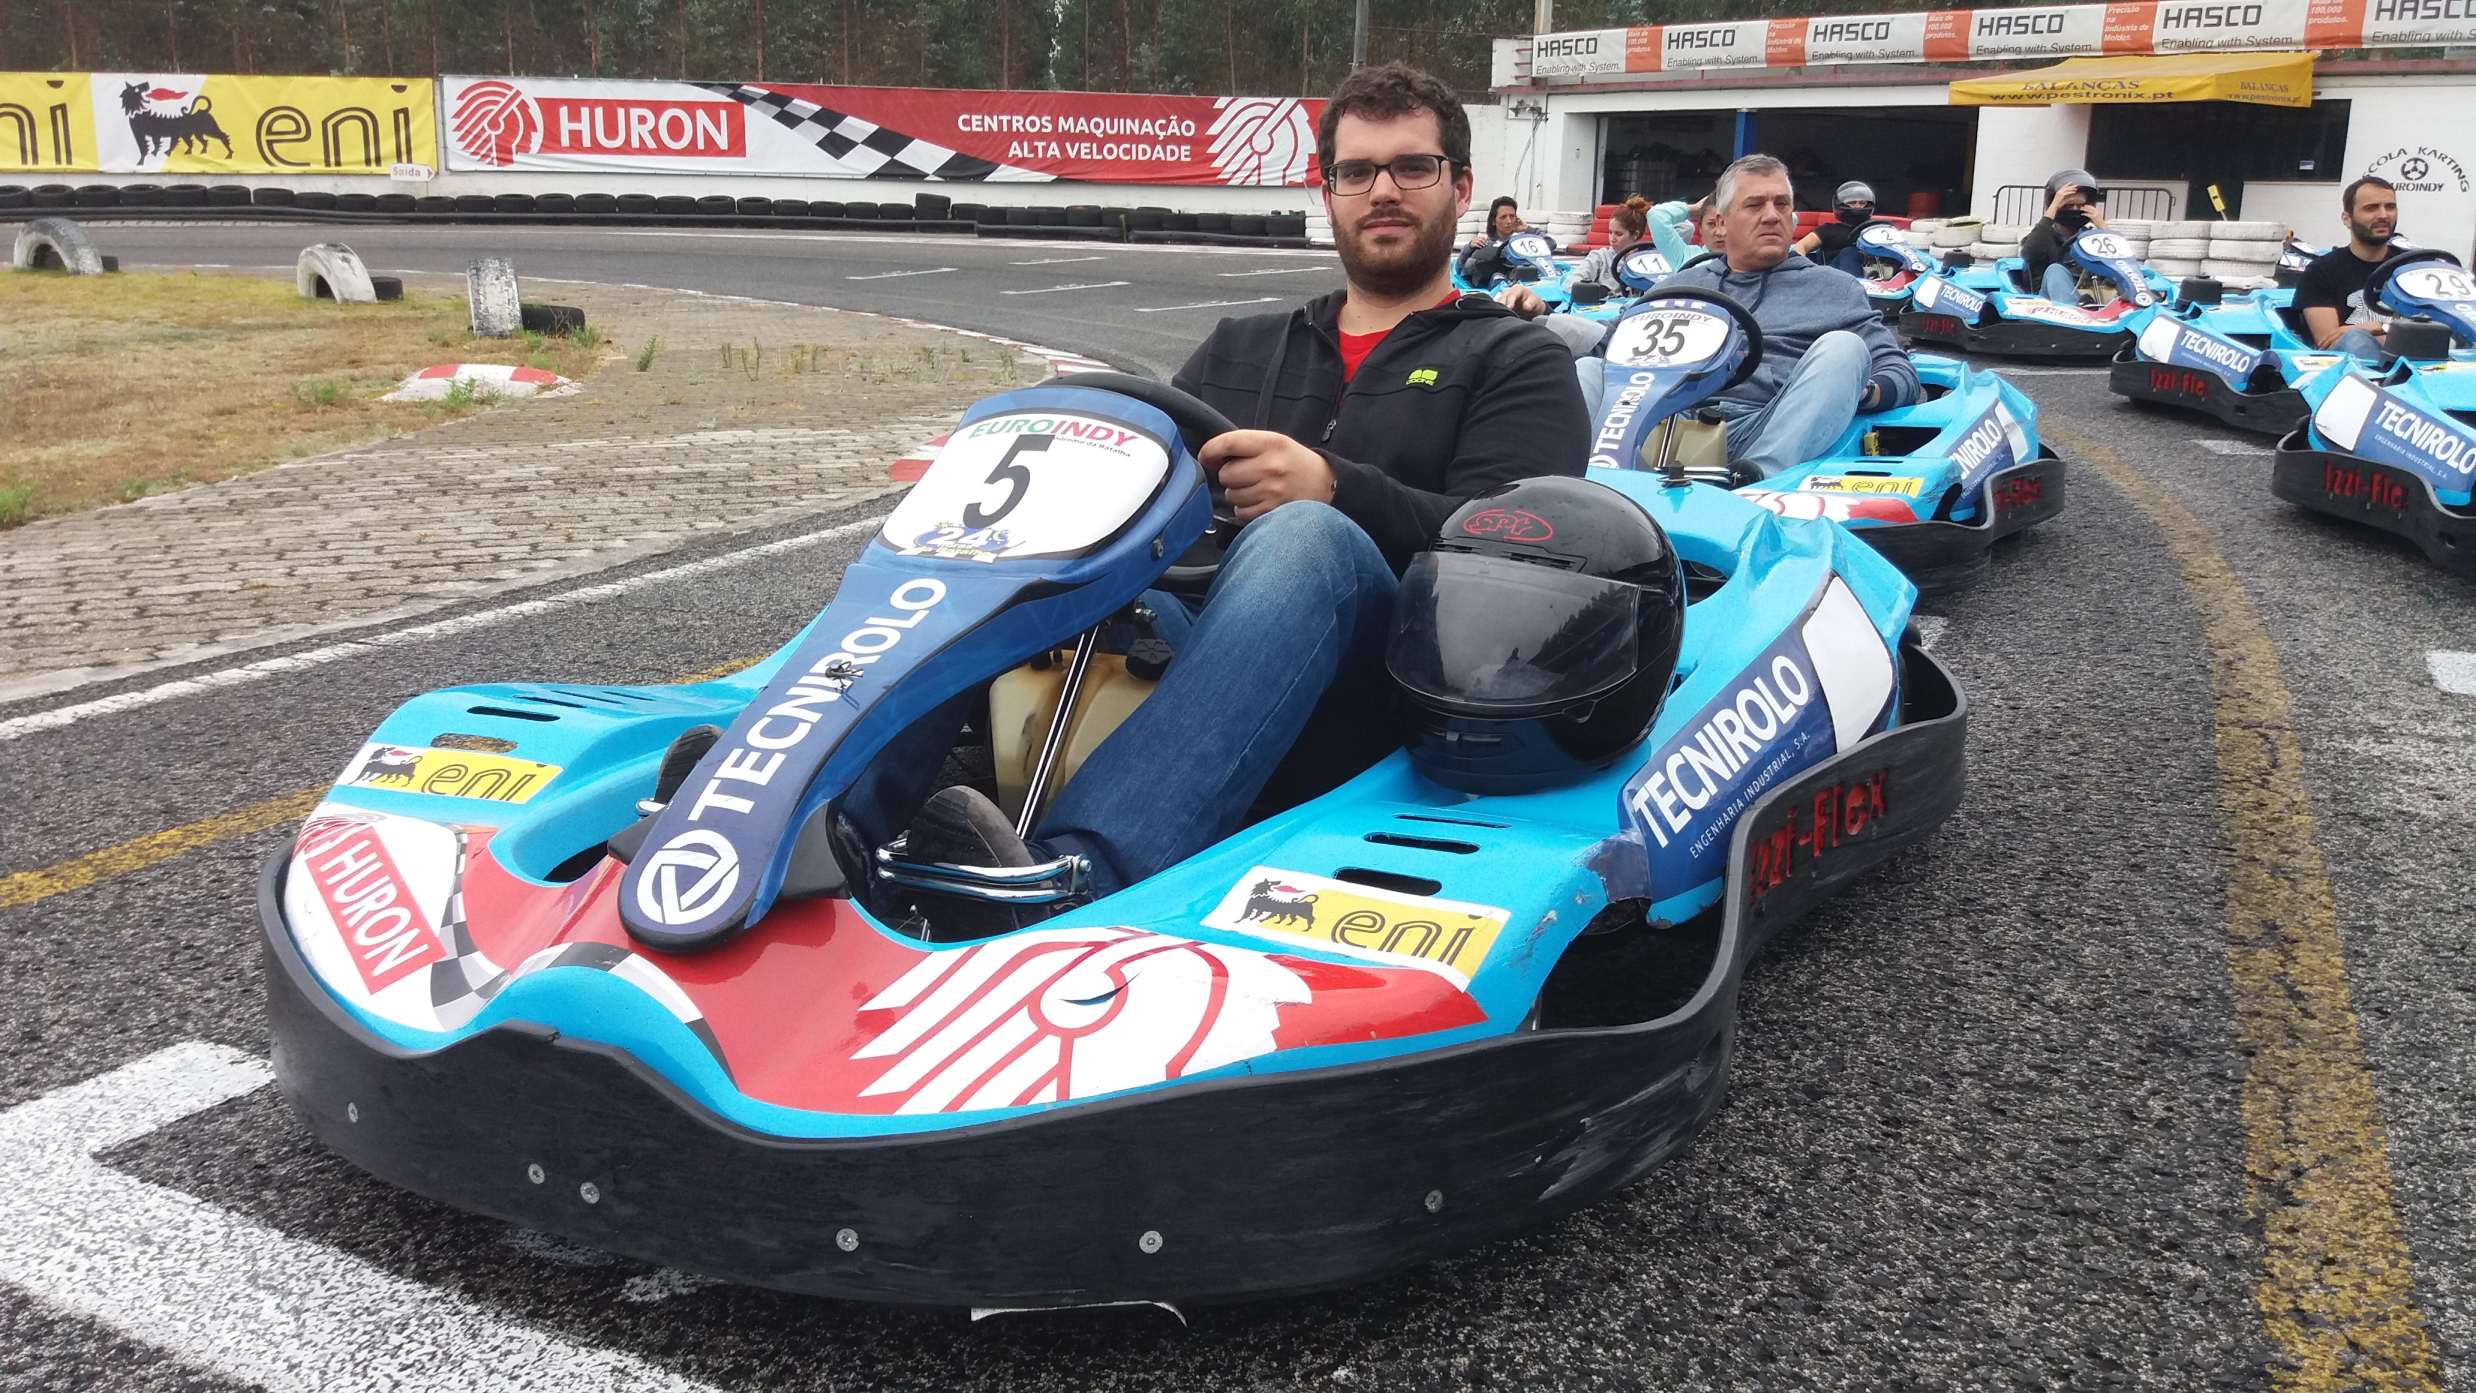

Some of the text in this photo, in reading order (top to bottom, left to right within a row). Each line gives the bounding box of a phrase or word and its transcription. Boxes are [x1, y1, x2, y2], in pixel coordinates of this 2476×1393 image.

[1977, 14, 2065, 36] HASCO
[2163, 5, 2262, 29] HASCO
[1668, 29, 1735, 49] HASCO
[1813, 22, 1891, 42] HASCO
[2162, 38, 2214, 49] Enabling
[2218, 37, 2242, 46] with
[2372, 31, 2430, 42] Enabling
[2436, 30, 2463, 40] with
[1537, 38, 1598, 58] HASCO
[1855, 50, 1875, 59] with
[1977, 45, 2022, 55] Enabling
[2025, 44, 2047, 53] with
[1667, 58, 1702, 68] Enabling
[1705, 56, 1721, 65] with
[0, 80, 74, 165] ni
[256, 84, 412, 167] eni
[559, 105, 729, 150] HURON
[957, 113, 1196, 139] CENTROS MAQUINAÇÃO
[1008, 142, 1192, 162] ALTA VELOCIDADE
[2362, 146, 2470, 193] COLA KARTING
[2392, 182, 2445, 192] UROINDY
[1519, 239, 1539, 254] 16
[1881, 229, 1894, 241] 2
[2091, 237, 2118, 255] 26
[2425, 273, 2471, 296] 29
[1941, 285, 1983, 313] TECNIROLO
[1631, 312, 1713, 323] EUROINDY
[1632, 318, 1691, 357] 35
[2180, 330, 2251, 373] TECNIROLO
[1592, 371, 1656, 454] TECNIROLO
[968, 418, 1139, 447] EUROINDY
[2373, 400, 2476, 475] TECNIROLO
[963, 434, 1056, 529] 5
[1852, 477, 1915, 495] eni
[688, 578, 947, 821] TECNIROLO
[1632, 655, 1810, 849] TECNIROLO
[420, 762, 548, 803] eni
[1689, 731, 1811, 860] ENGENHARIA INDUSTRIAL, S.A.
[318, 839, 430, 978] HURON
[1330, 909, 1484, 967] eni
